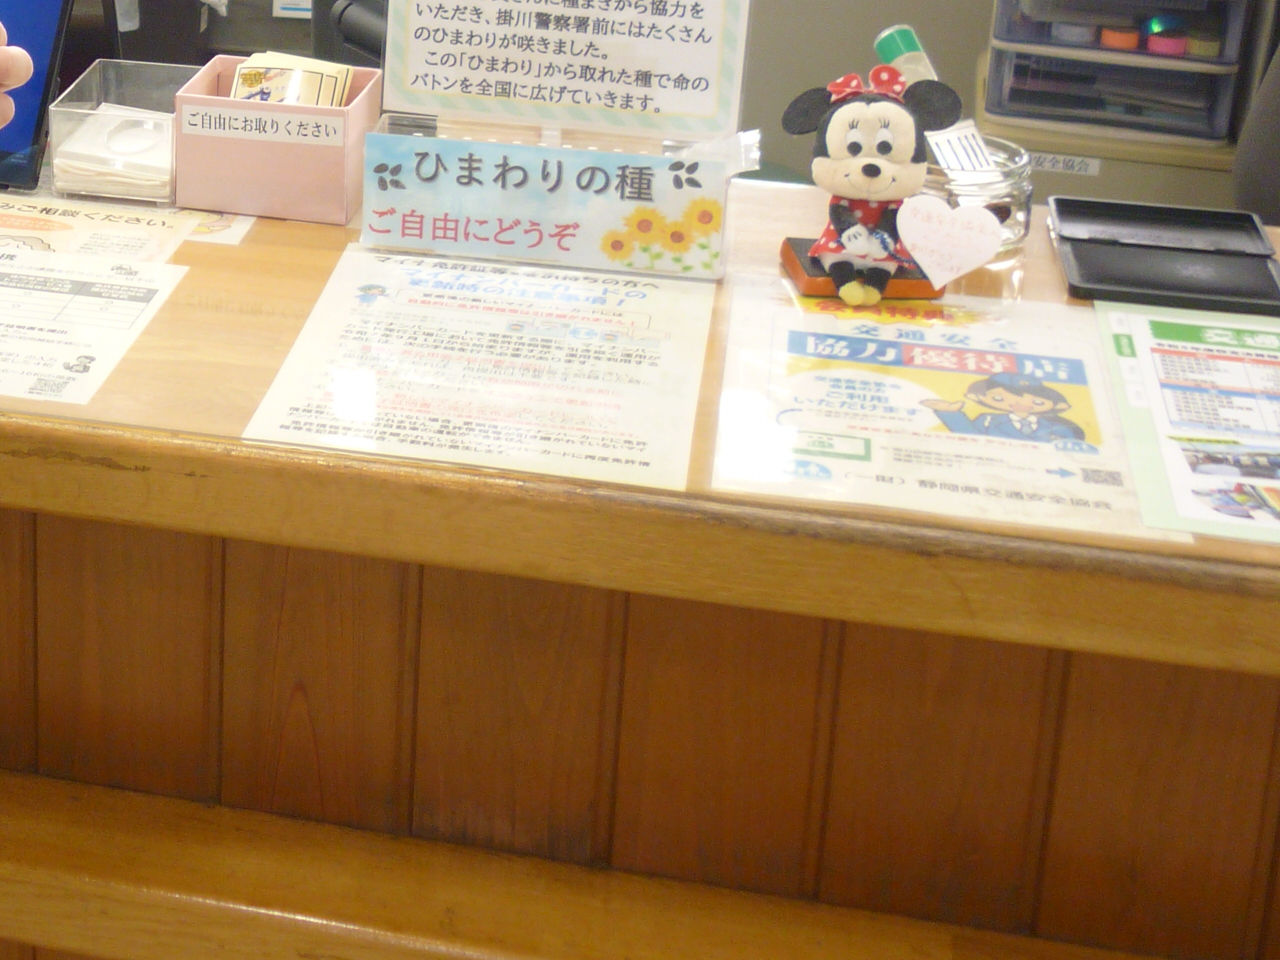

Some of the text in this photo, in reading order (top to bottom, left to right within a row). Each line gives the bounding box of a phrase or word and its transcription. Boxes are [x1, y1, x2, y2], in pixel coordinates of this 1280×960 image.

[416, 2, 712, 44] いただき、掛川警察署前にはたくさん
[413, 26, 609, 60] のひまわりが咲きました。
[424, 50, 710, 92] この「ひまわり」から取れた種で命の
[410, 73, 662, 114] バトンを全国に広げていきます。
[187, 111, 337, 138] ご自由にお取りください
[414, 151, 656, 203] ひまわりの種
[367, 207, 580, 252] ご自由にどうぞ
[852, 323, 1021, 350] 交通安全
[805, 335, 1074, 381] 協力優待店
[793, 395, 921, 417] いただけます
[824, 389, 888, 404] ご利用
[916, 478, 1113, 511] 静岡県交通安全協会
